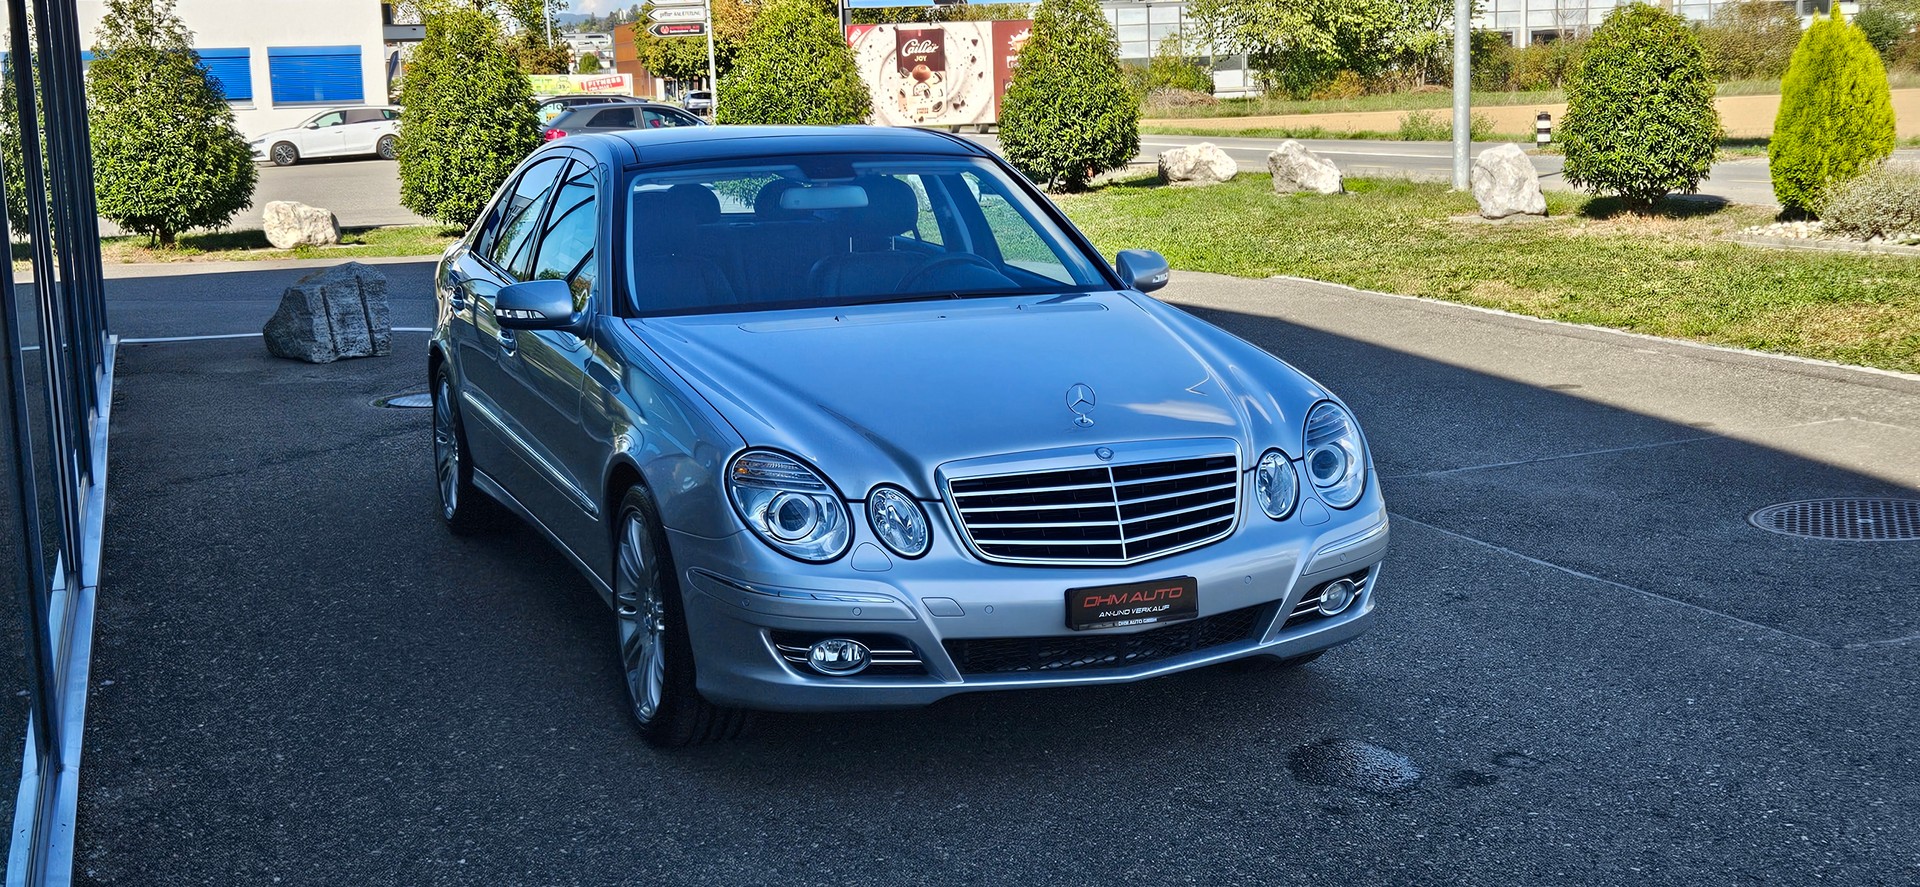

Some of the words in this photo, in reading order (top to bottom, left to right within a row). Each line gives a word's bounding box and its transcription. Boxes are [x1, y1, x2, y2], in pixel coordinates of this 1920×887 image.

[901, 38, 940, 57] Cailler
[587, 76, 622, 88] FITNESS
[1129, 587, 1183, 604] AUTO
[1131, 604, 1170, 614] VERKAUF
